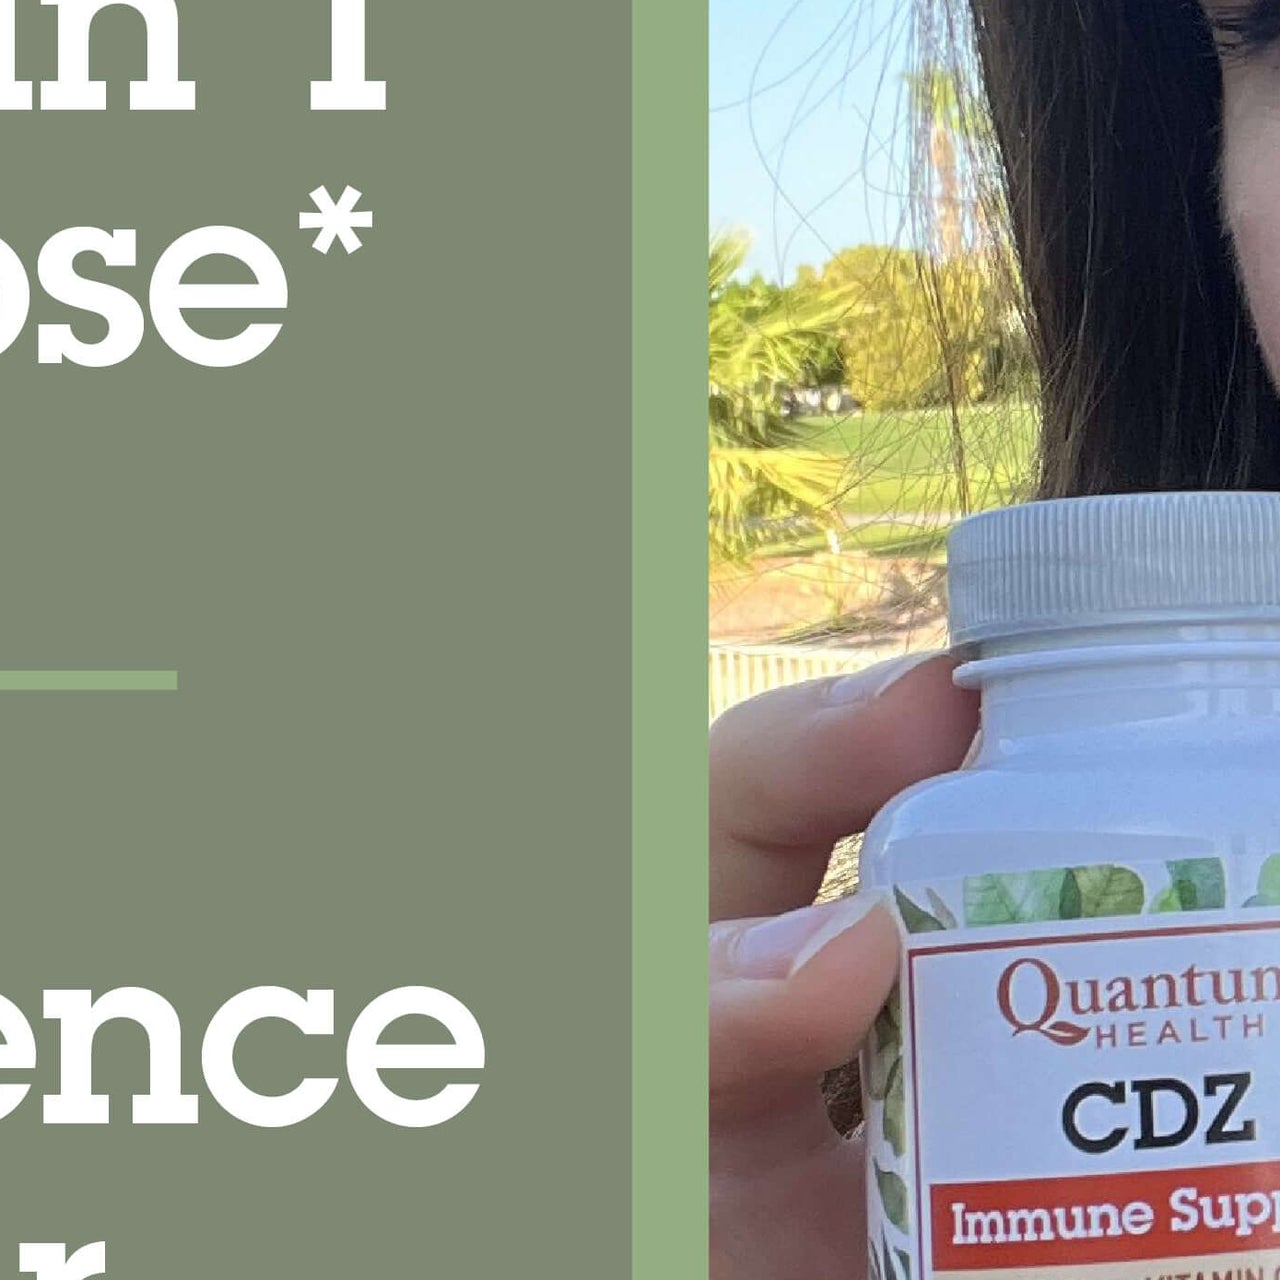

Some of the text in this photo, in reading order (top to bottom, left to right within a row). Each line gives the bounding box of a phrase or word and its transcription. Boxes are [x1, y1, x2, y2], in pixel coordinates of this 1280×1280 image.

[1095, 1014, 1264, 1049] HEALTH
[1062, 1072, 1256, 1153] CDZ
[952, 1201, 1154, 1244] Immune
